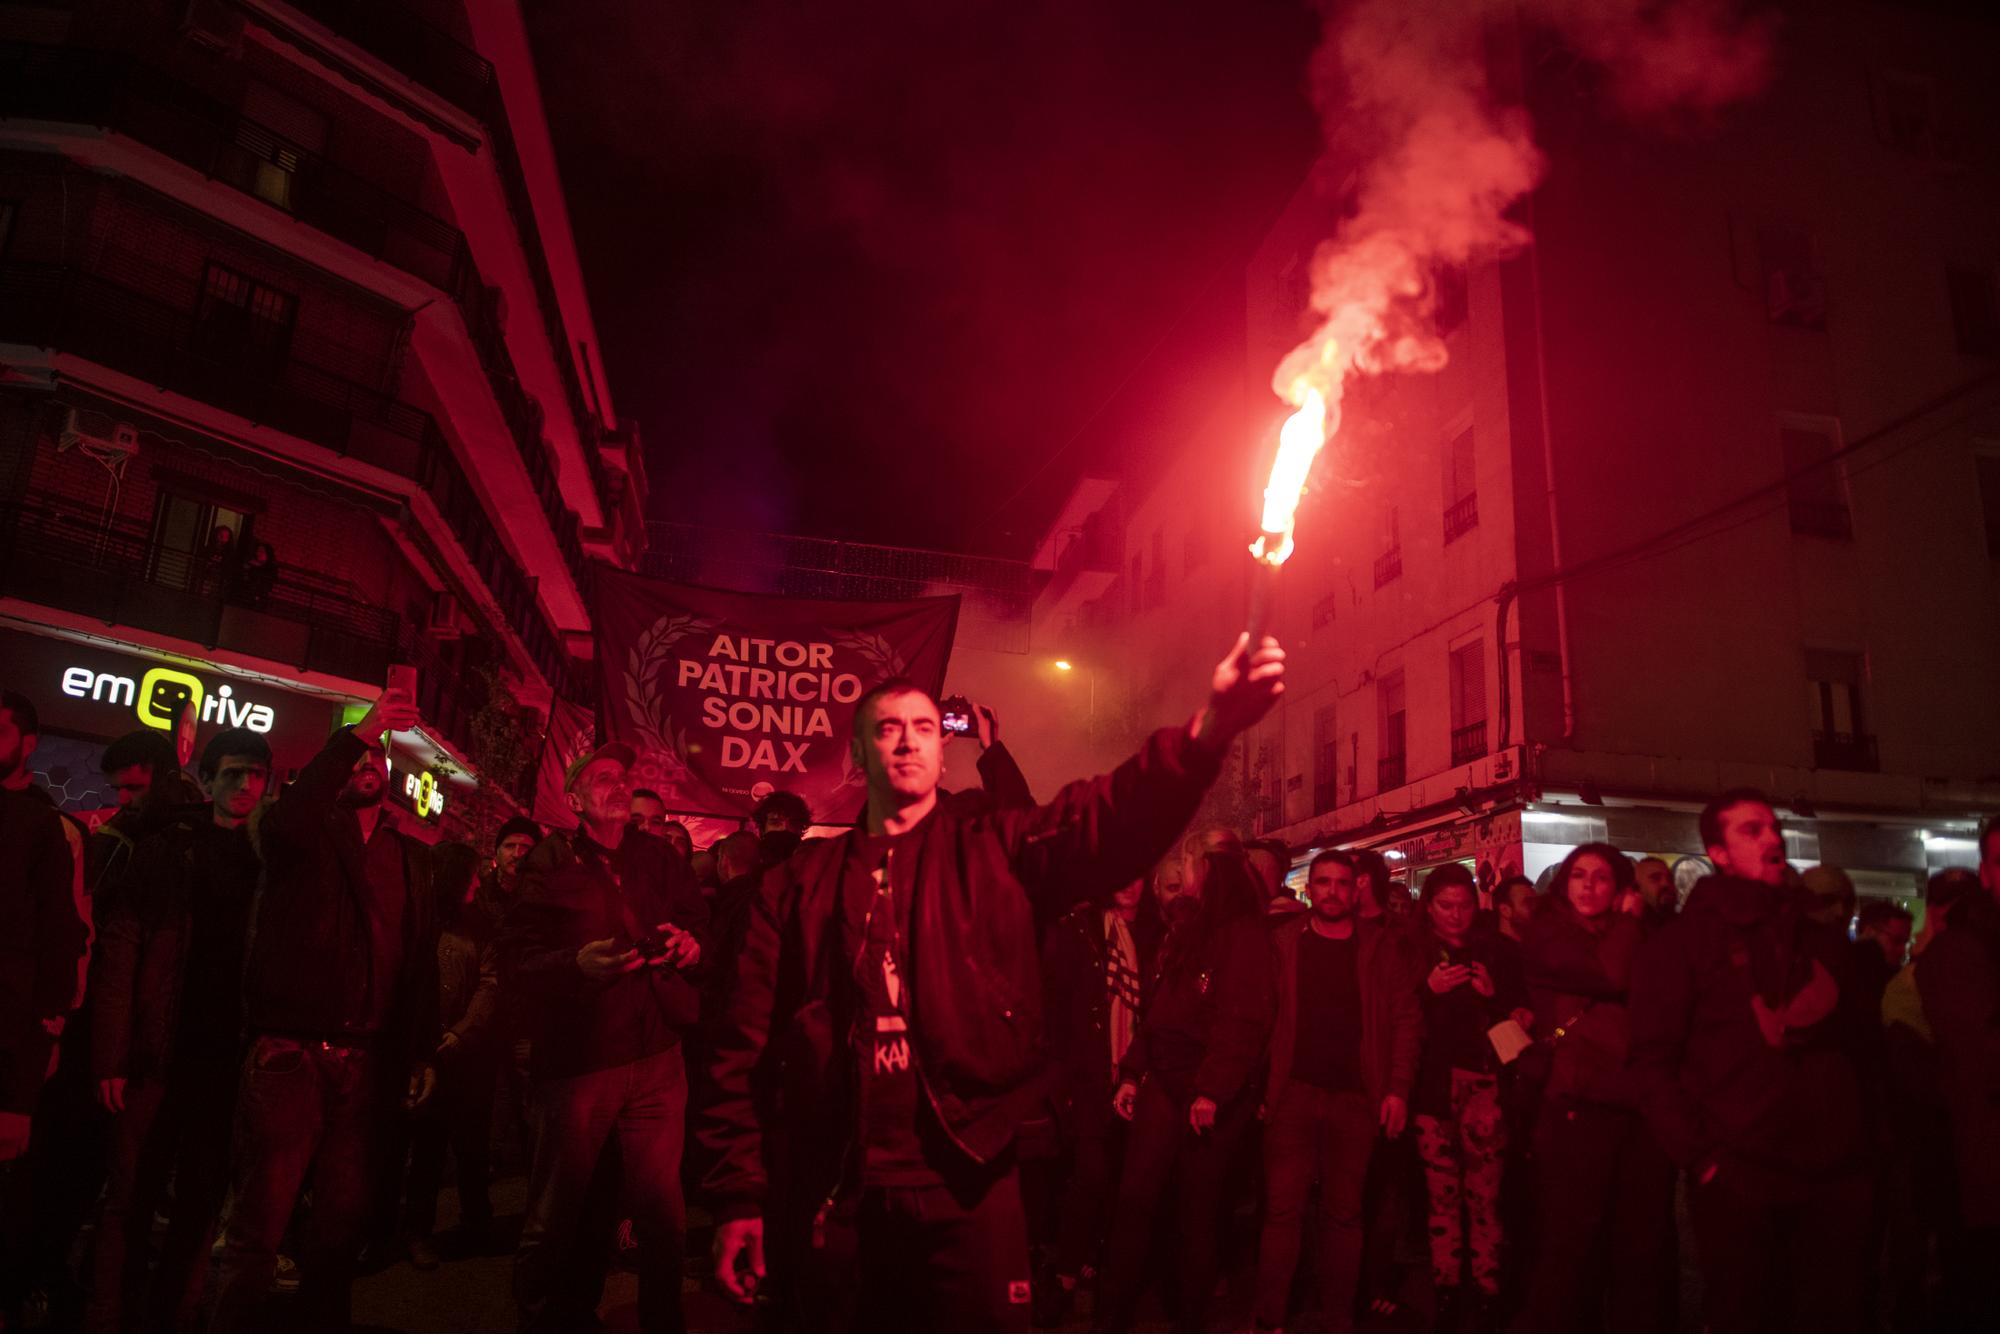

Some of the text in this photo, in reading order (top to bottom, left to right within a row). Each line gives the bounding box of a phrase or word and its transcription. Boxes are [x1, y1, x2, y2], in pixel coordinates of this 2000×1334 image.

[708, 634, 833, 669] AITOR
[678, 660, 862, 703] PATRICIO
[702, 697, 833, 738] SONIA
[721, 736, 810, 773] DAX
